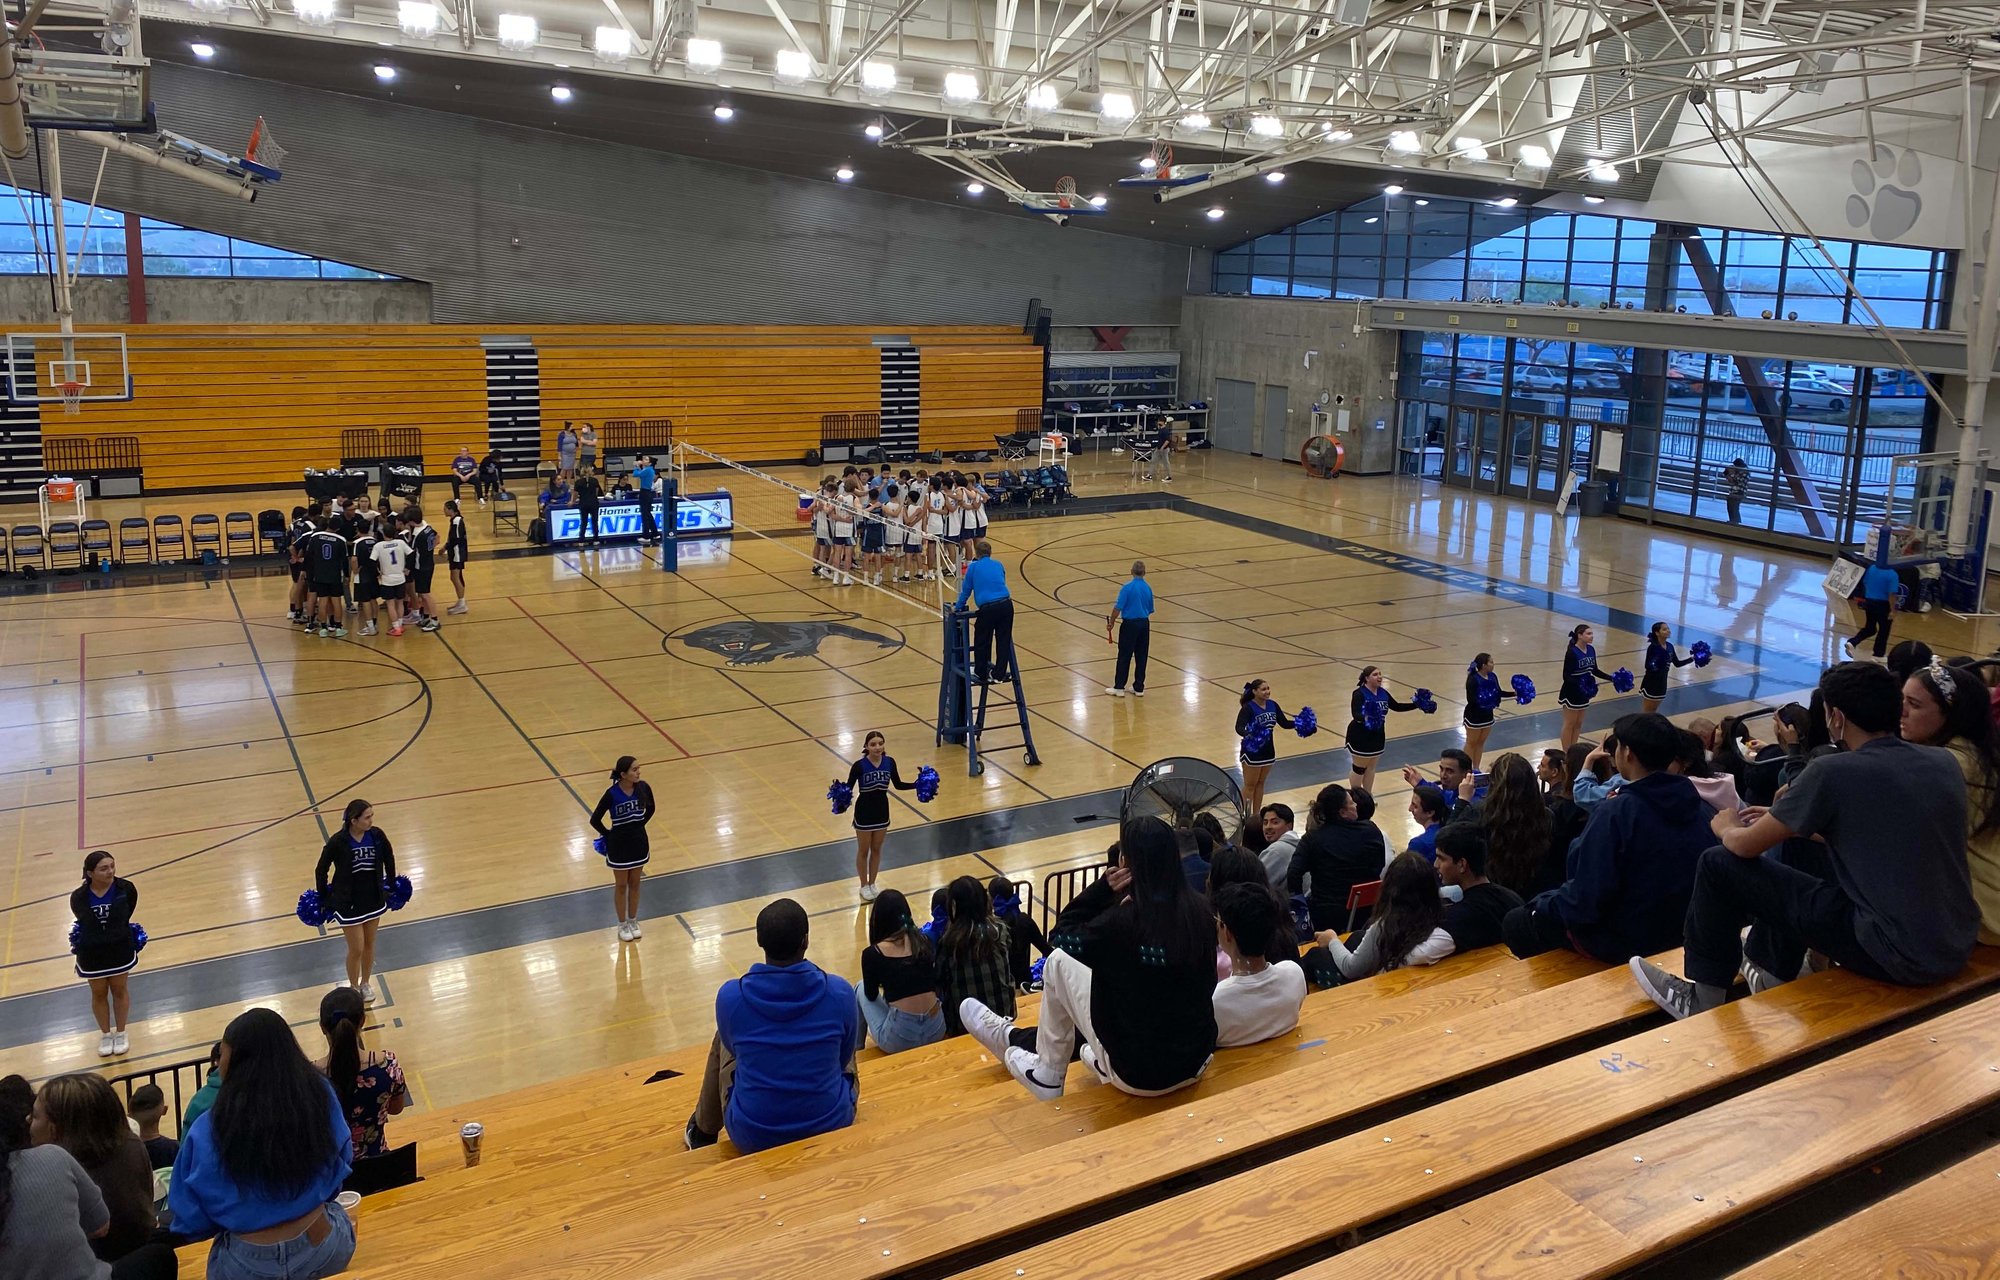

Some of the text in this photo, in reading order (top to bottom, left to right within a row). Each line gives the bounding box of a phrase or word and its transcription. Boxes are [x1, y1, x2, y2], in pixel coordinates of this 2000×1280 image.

[600, 508, 631, 516] Home
[389, 549, 398, 565] 1
[1335, 545, 1526, 595] PANTHERS
[864, 770, 891, 785] DRHS
[616, 799, 641, 817] DRH
[352, 846, 376, 862] RHS
[90, 903, 112, 920] RH
